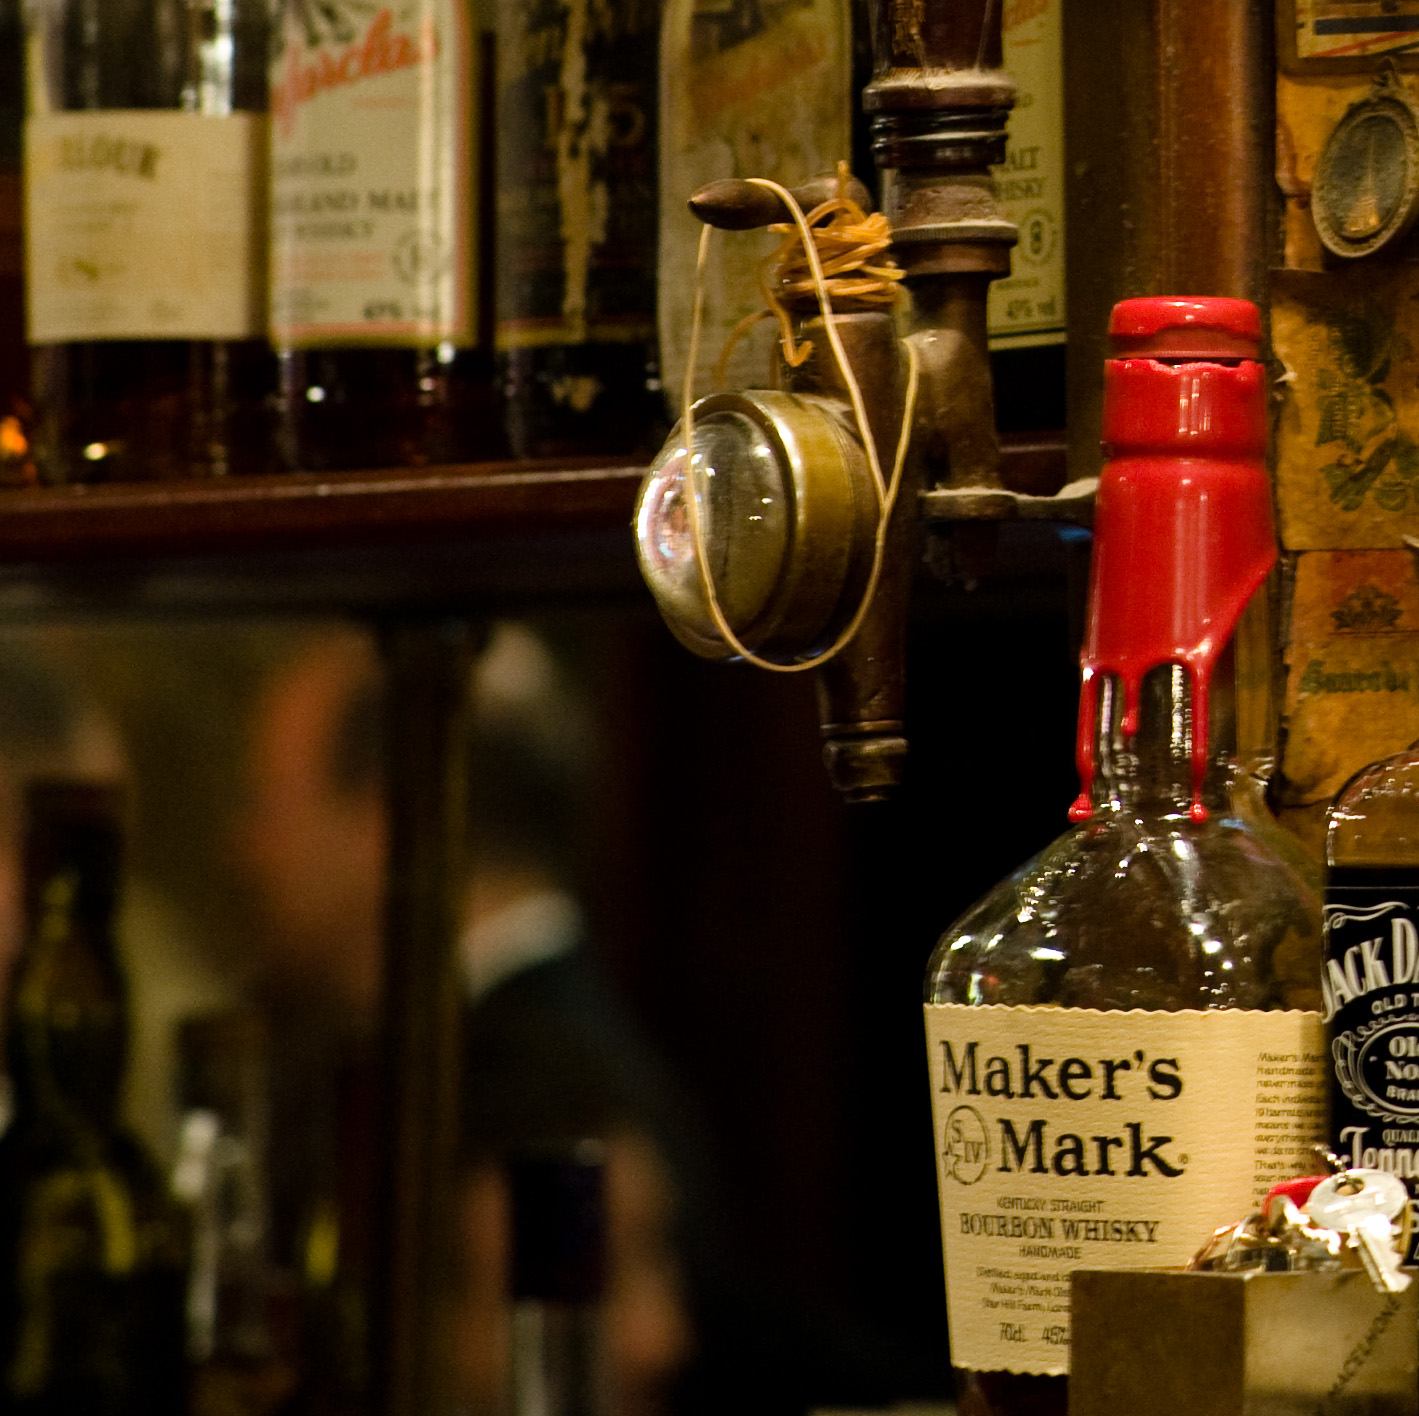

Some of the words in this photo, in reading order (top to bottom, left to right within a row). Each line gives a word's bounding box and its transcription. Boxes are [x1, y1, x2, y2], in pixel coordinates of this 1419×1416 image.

[1321, 936, 1388, 1025] JACK
[1370, 995, 1408, 1016] OLD
[938, 1039, 1184, 1102] Maker's
[997, 1117, 1187, 1179] Mark
[996, 1196, 1046, 1212] KENTUCKY
[1049, 1198, 1107, 1214] STRAIGHT
[959, 1212, 1055, 1240] BOURBON
[1059, 1218, 1161, 1244] WHISKY
[1018, 1244, 1083, 1260] HANDMADE
